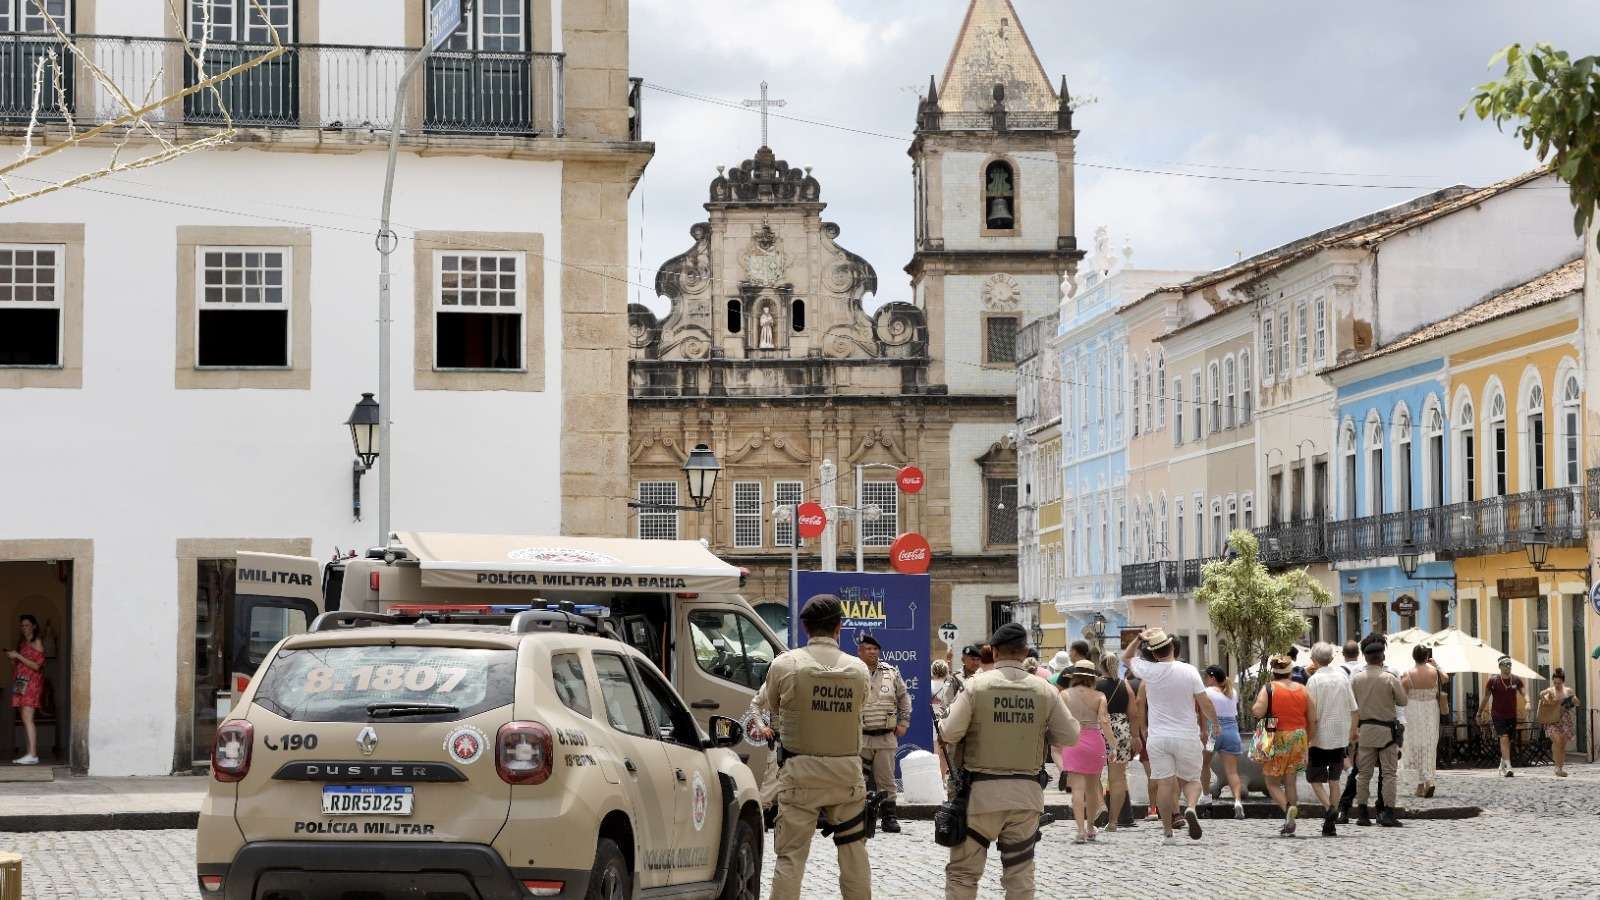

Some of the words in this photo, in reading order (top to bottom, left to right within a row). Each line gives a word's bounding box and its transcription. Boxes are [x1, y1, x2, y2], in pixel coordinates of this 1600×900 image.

[239, 568, 312, 586] MILITAR
[477, 571, 537, 585] POLÍCIA
[542, 575, 607, 588] MILITAR
[612, 576, 633, 588] DA
[638, 576, 686, 588] BAHIA
[840, 600, 885, 619] NATAL
[943, 631, 955, 640] 14
[303, 665, 468, 695] 8.1807
[812, 685, 854, 699] POLÍCIA
[811, 700, 853, 713] MILITAR
[993, 694, 1035, 709] POLÍCIA
[993, 711, 1035, 724] MILITAR
[279, 734, 318, 750] 190
[306, 765, 427, 776] DUSTER
[330, 794, 404, 811] RDR5D25
[294, 819, 358, 834] POLÍCIA
[364, 822, 435, 836] MILITAR
